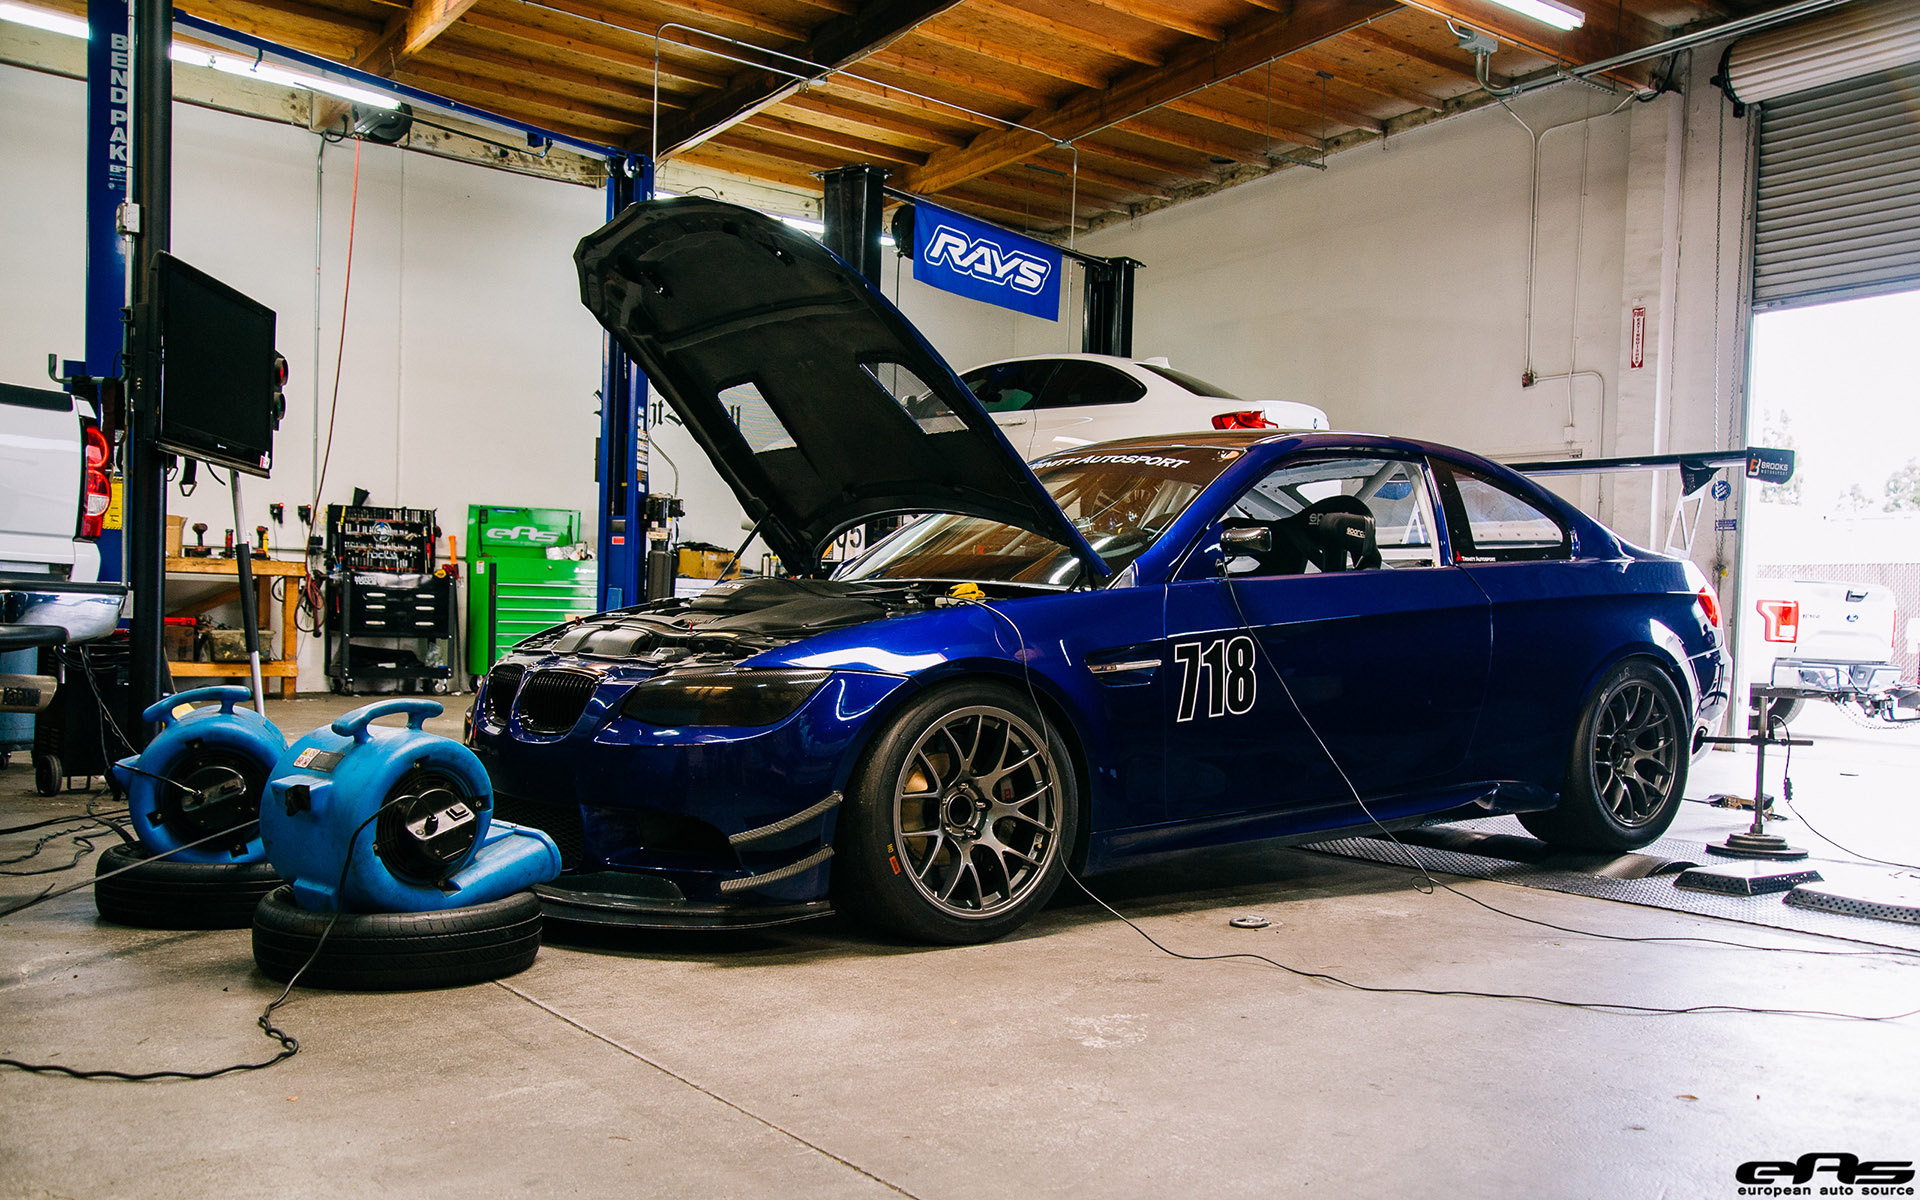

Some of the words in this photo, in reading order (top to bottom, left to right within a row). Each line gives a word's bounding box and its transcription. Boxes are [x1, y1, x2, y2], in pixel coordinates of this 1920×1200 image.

[111, 33, 128, 104] BEND
[110, 109, 127, 161] PAK
[928, 230, 1048, 290] RAYS
[1075, 454, 1190, 469] AUTOSPORT
[1761, 461, 1789, 472] BROOKS
[1174, 636, 1257, 723] 718
